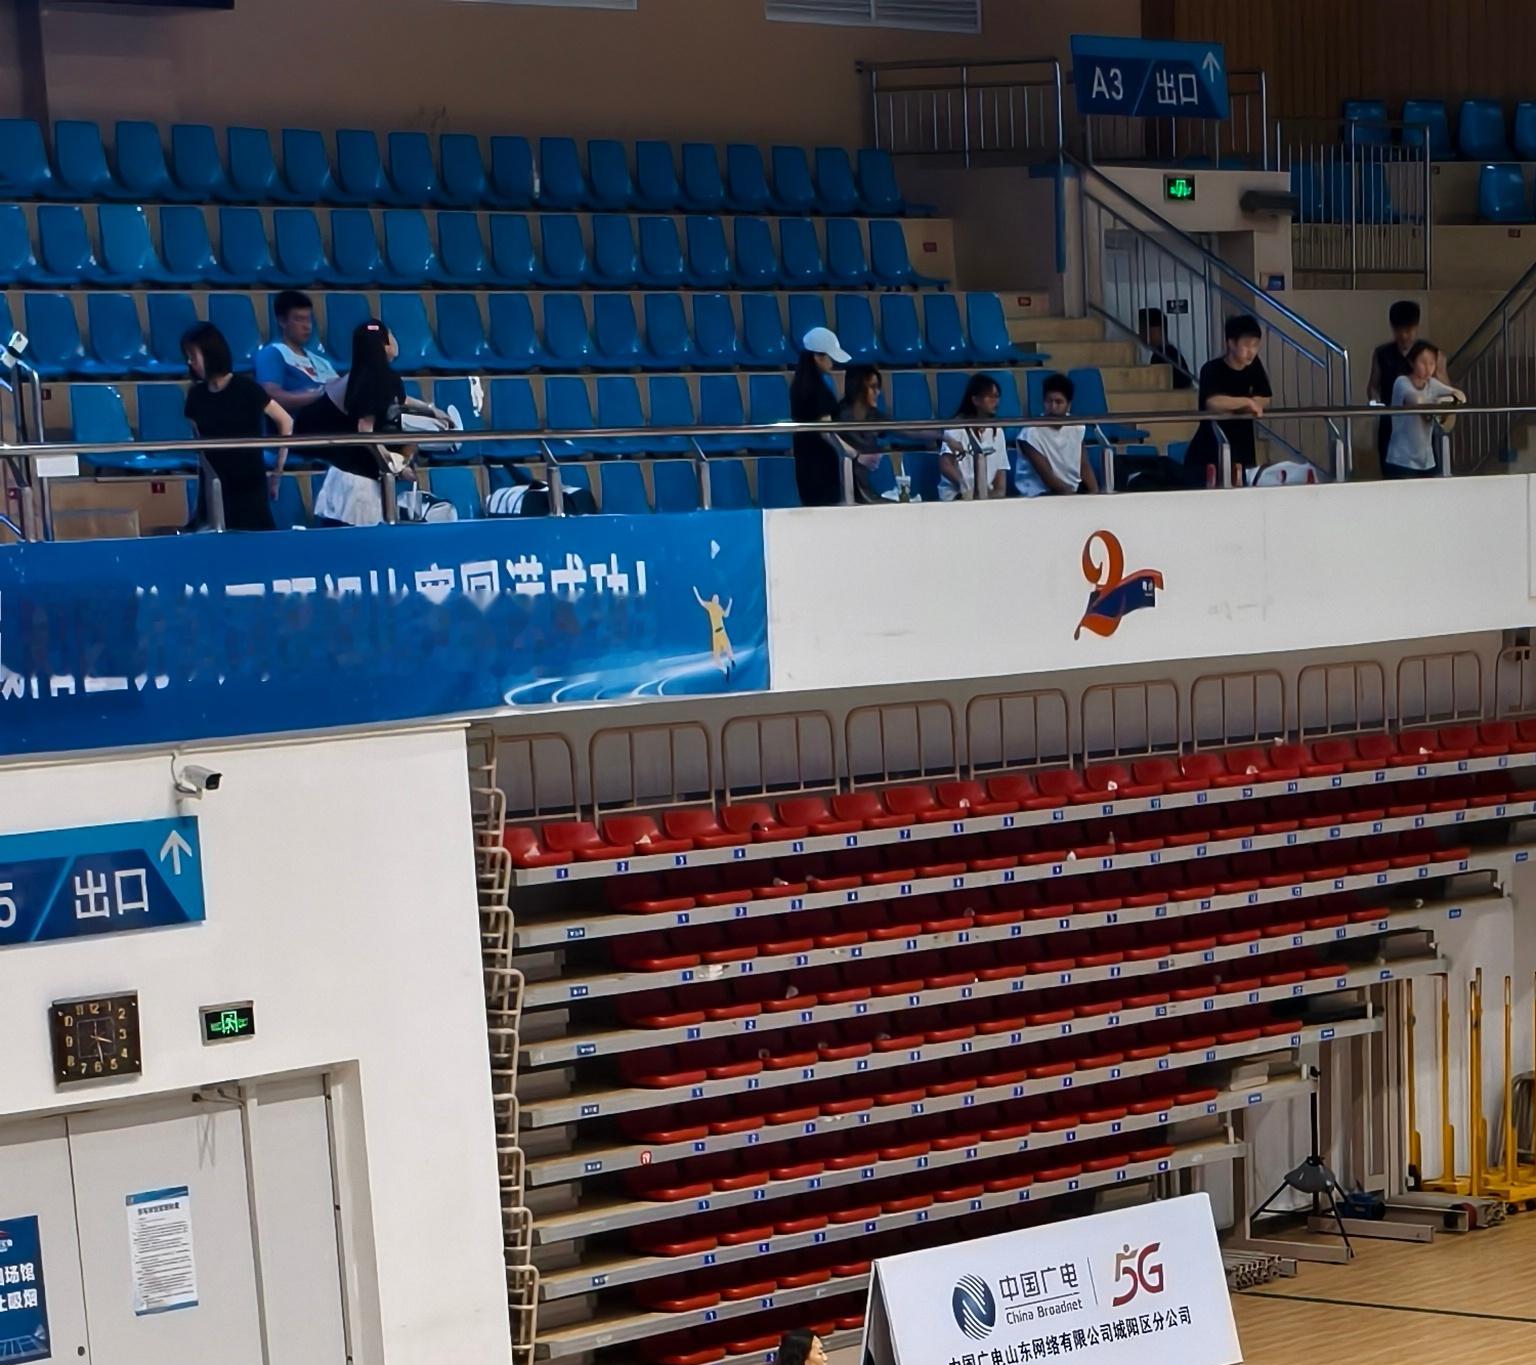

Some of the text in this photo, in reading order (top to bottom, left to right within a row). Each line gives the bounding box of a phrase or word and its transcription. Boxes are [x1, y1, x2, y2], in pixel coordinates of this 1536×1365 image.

[1092, 66, 1198, 105] A3 出口
[75, 869, 149, 919] 出口
[1000, 1242, 1164, 1307] 中国广电 5G
[1006, 1298, 1084, 1325] China Broadnet
